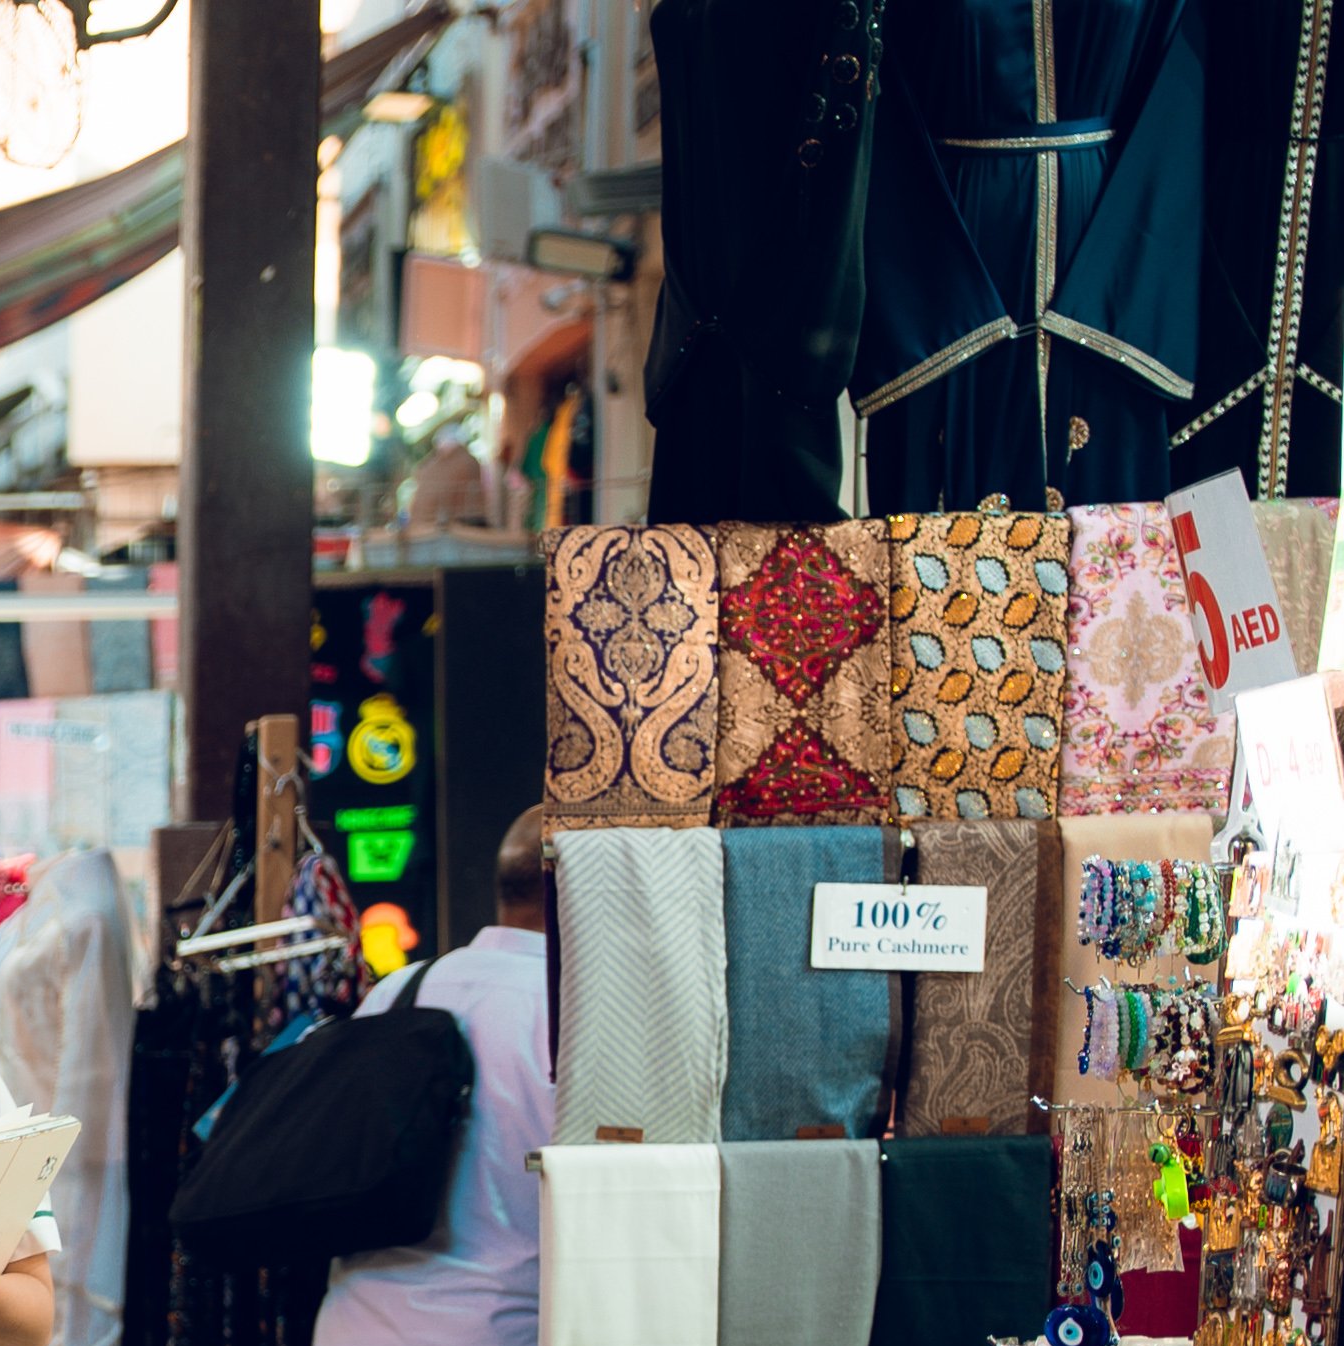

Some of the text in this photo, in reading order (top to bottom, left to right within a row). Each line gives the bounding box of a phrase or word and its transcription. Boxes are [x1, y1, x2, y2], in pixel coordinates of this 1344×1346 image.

[1231, 603, 1280, 653] AED
[853, 899, 948, 932] 100%
[828, 936, 969, 956] Pure Cashmere
